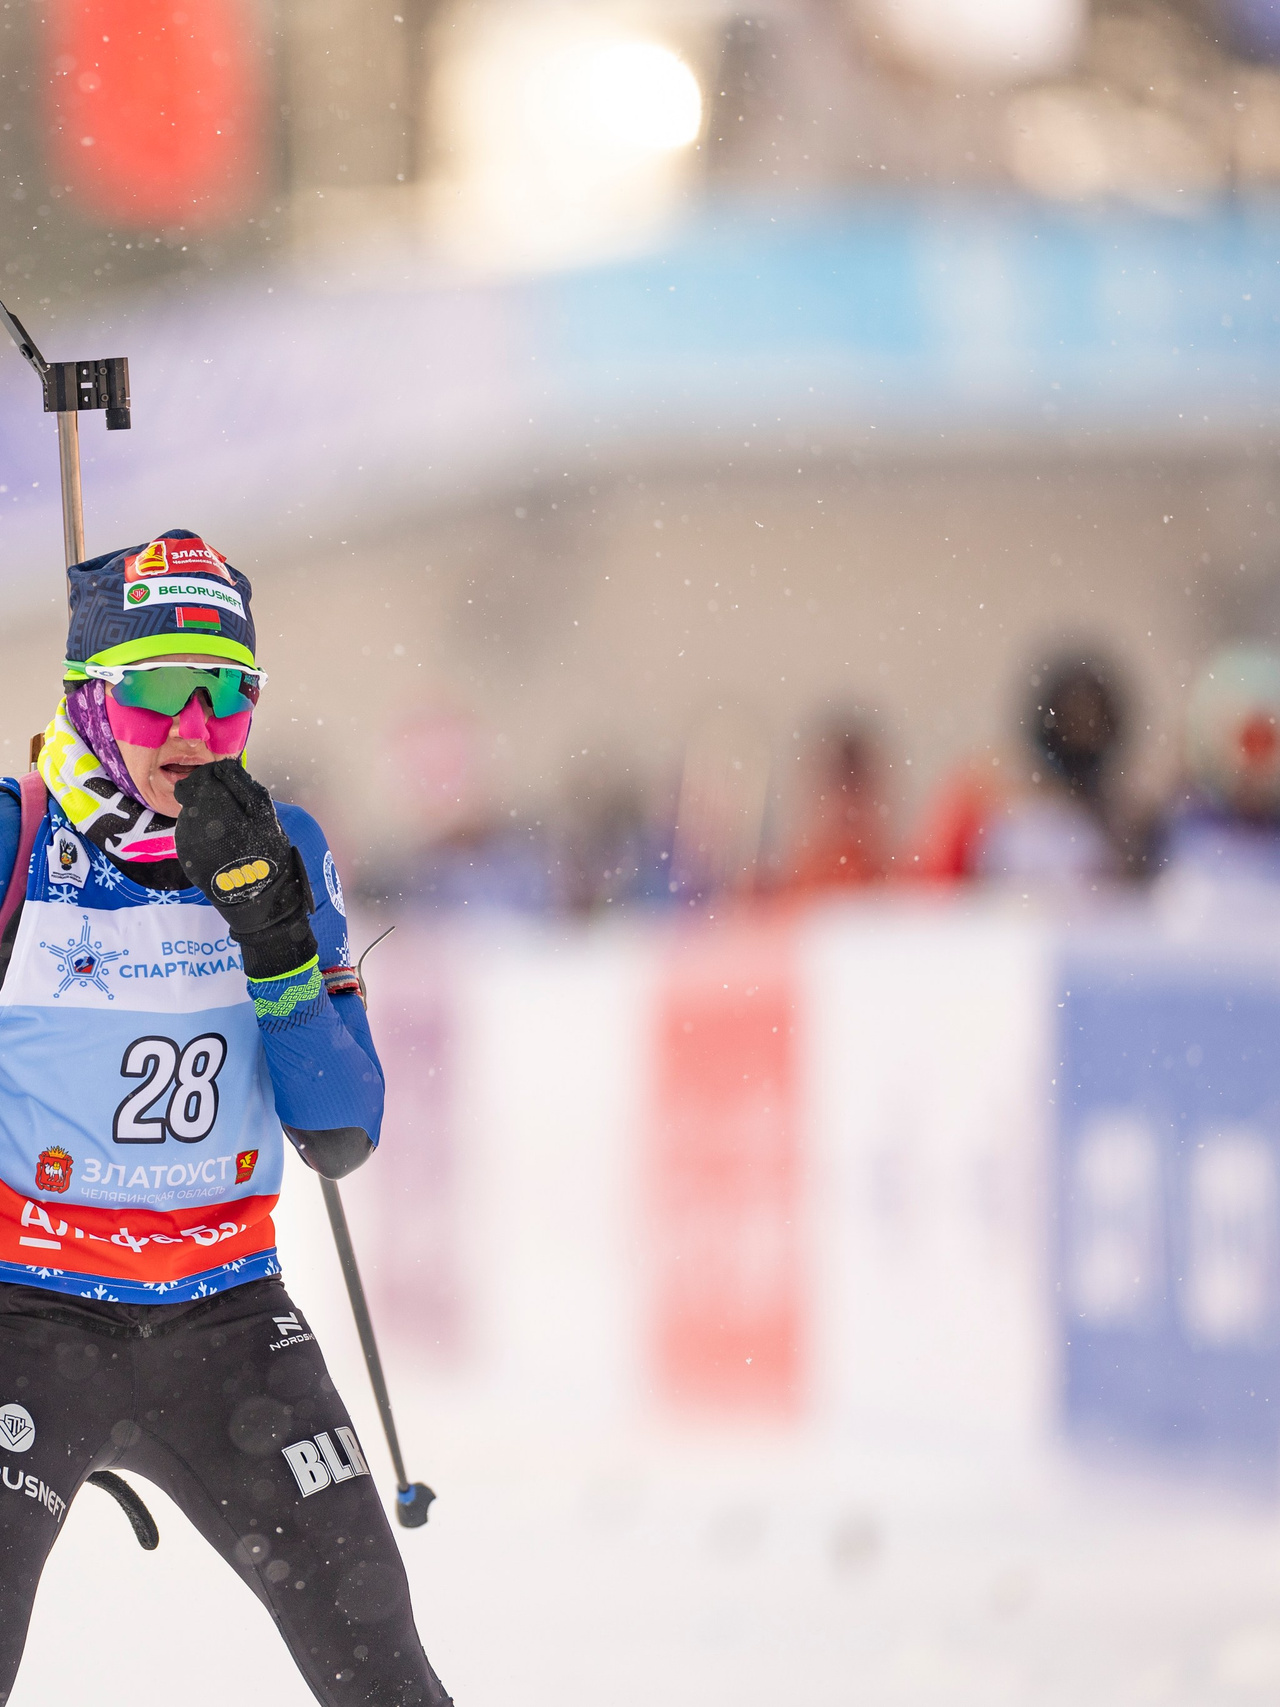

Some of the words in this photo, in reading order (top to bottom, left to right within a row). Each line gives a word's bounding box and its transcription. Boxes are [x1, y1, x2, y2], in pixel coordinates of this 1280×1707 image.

[170, 549, 215, 560] ЗЛАТО
[158, 585, 241, 610] BELORUSNEFT
[161, 935, 242, 956] ВСЕРОСС
[113, 1032, 227, 1144] 28
[80, 1154, 232, 1189] ЗЛАТОУСТ
[80, 1187, 175, 1204] ЧЕЛЯБИНСКАЯ
[176, 1185, 226, 1199] ОБЛАСТЬ
[281, 1425, 370, 1498] BLR
